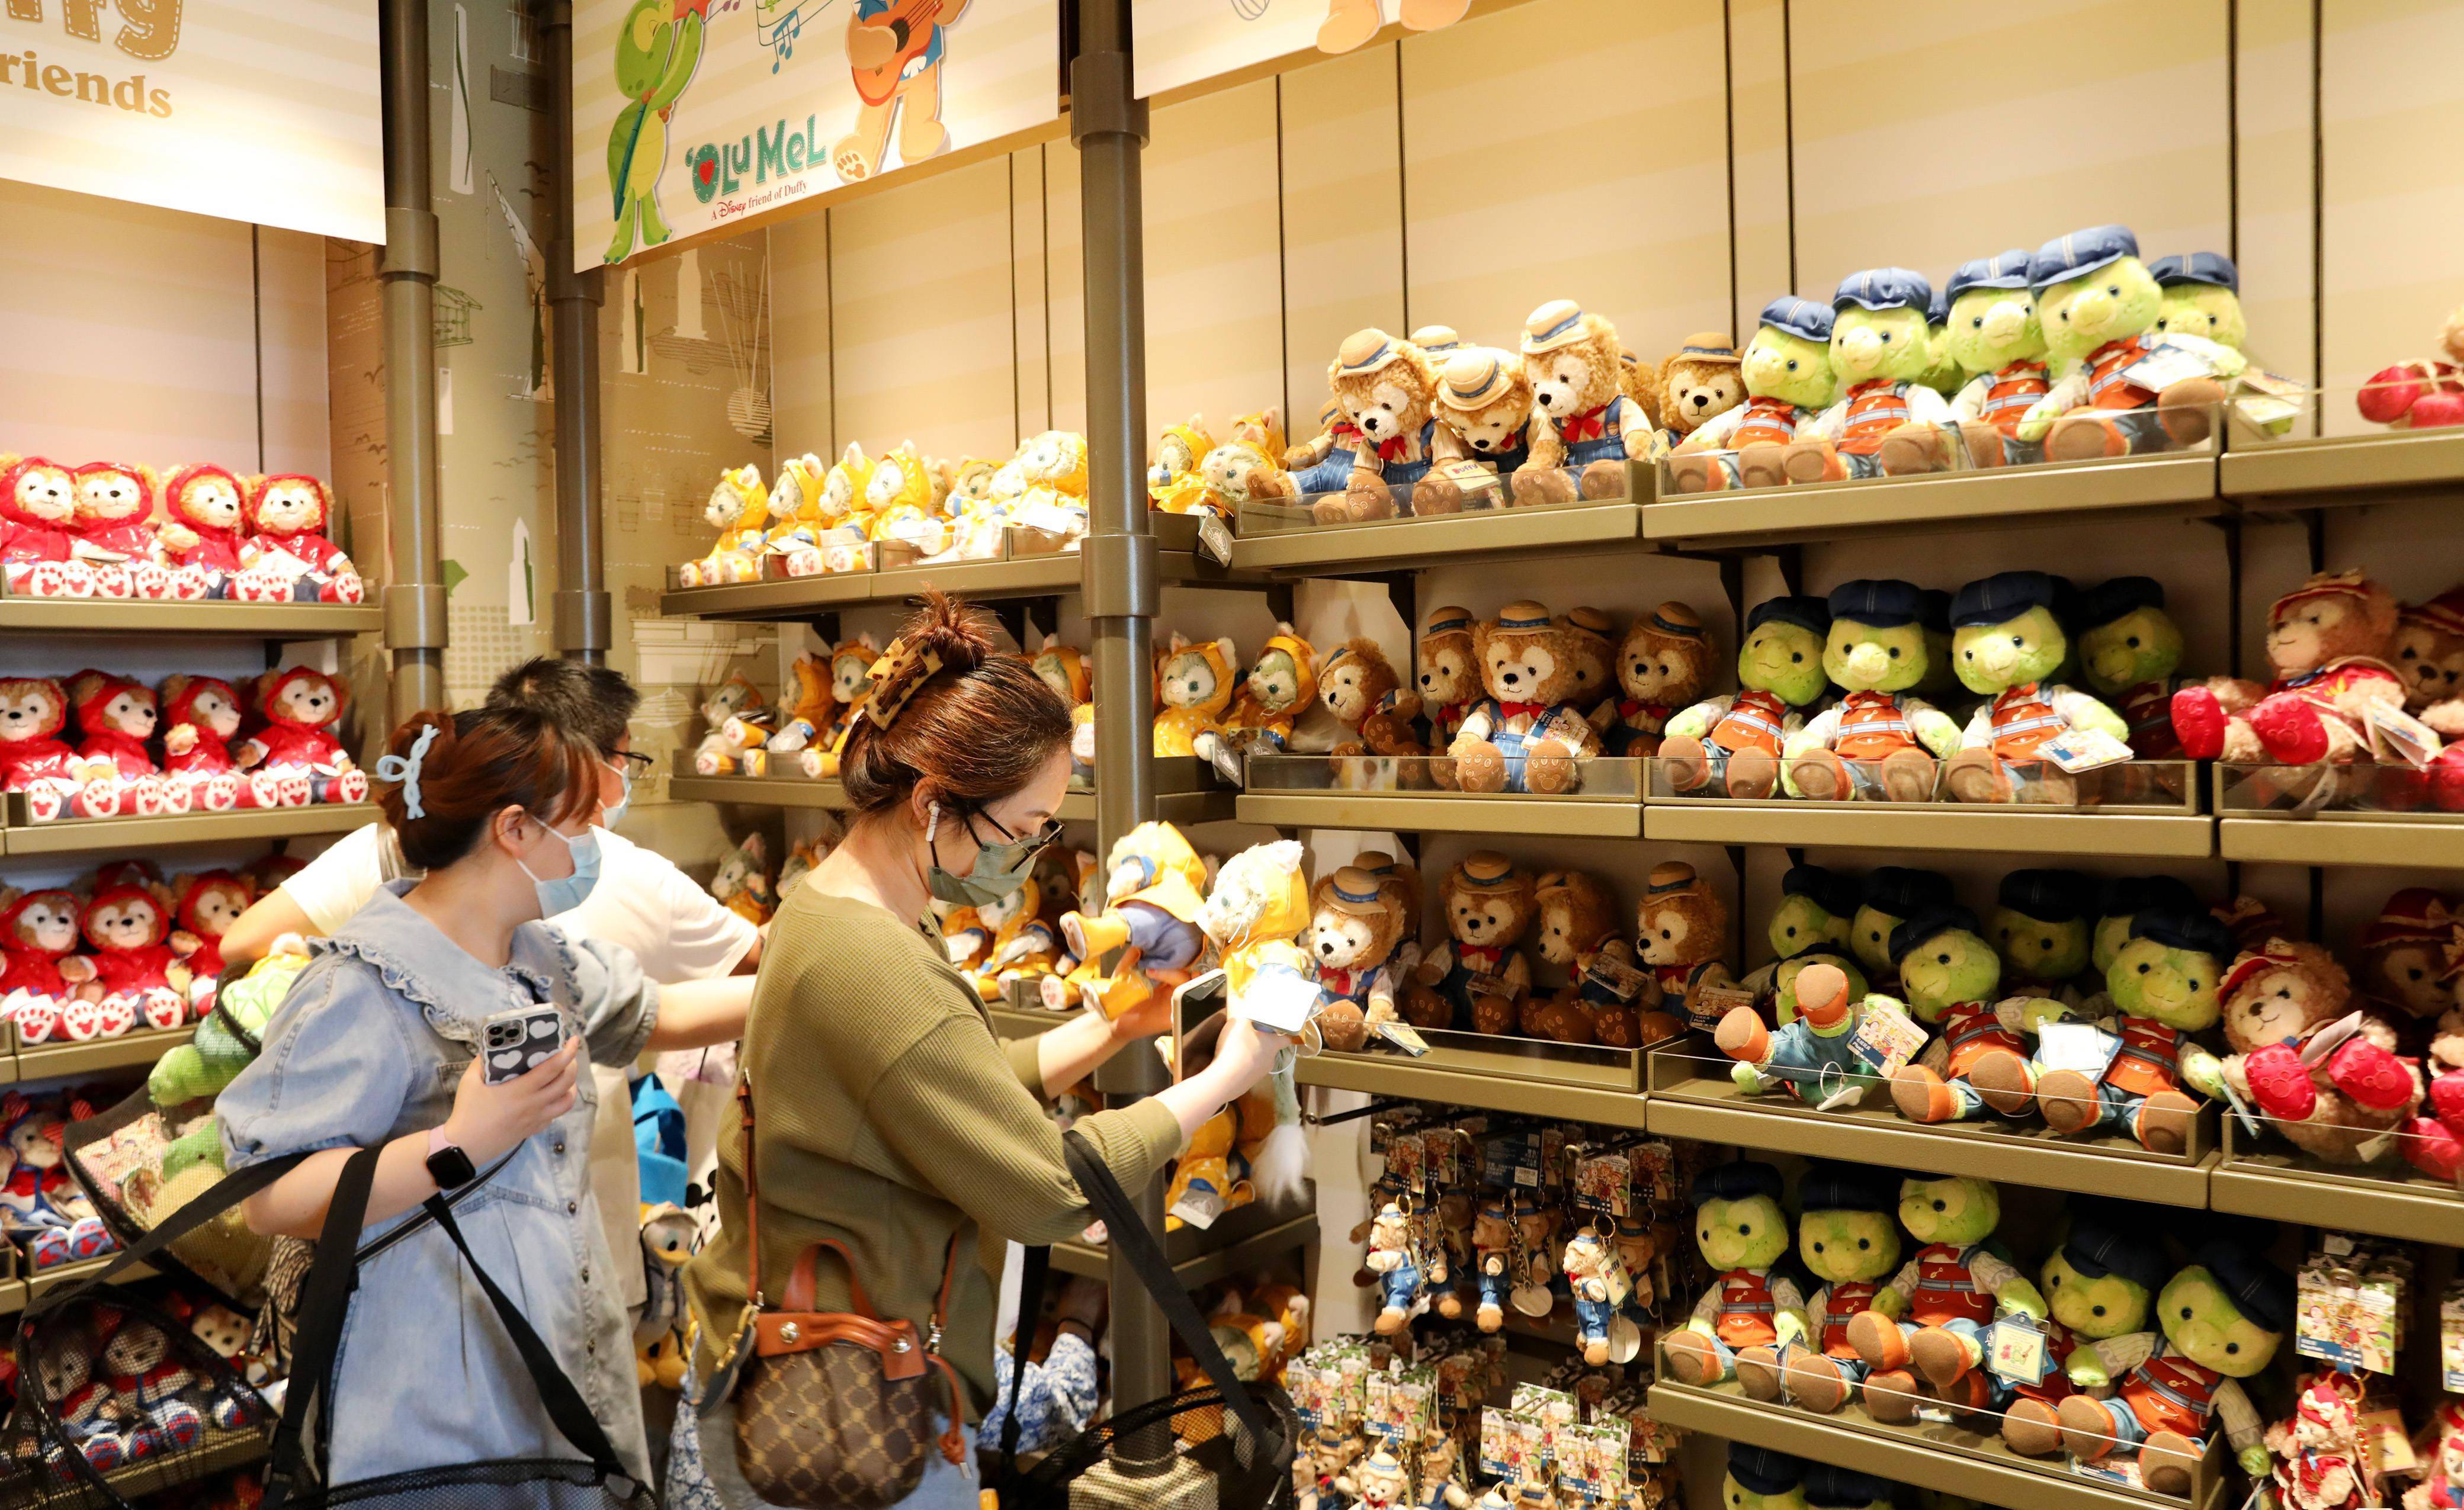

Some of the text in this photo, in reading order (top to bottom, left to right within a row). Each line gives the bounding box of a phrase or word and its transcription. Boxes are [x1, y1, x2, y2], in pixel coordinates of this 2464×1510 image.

[711, 179, 808, 221] A Disney friend of Duffy
[1852, 1040, 1865, 1053] Plush
[1605, 1258, 1620, 1280] Duffy
